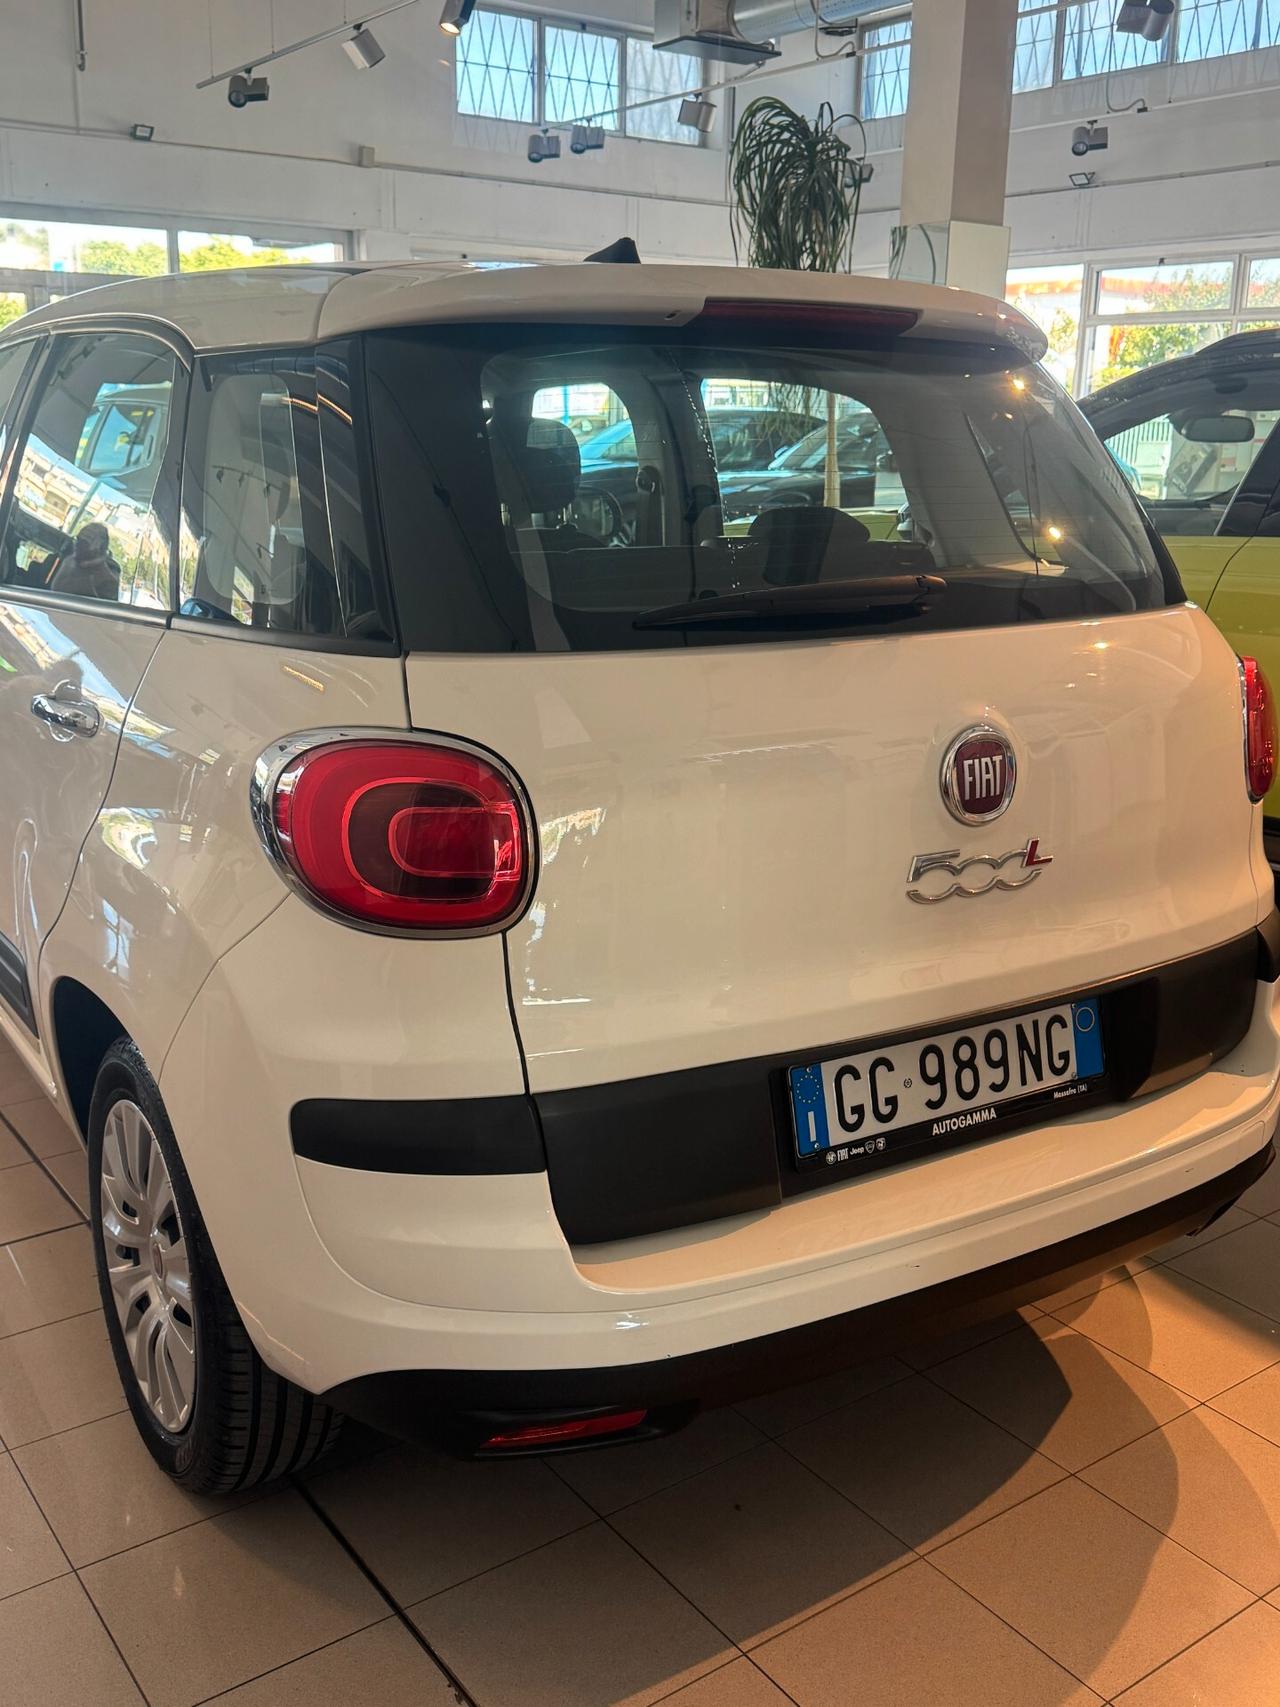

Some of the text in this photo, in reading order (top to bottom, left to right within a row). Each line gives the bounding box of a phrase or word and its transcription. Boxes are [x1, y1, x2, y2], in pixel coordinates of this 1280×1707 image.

[963, 755, 1003, 801] FIAT
[906, 837, 1054, 904] 500L
[932, 1107, 997, 1136] AUTOGAMMA
[837, 1147, 849, 1162] FIAT
[850, 1146, 865, 1156] Jeep
